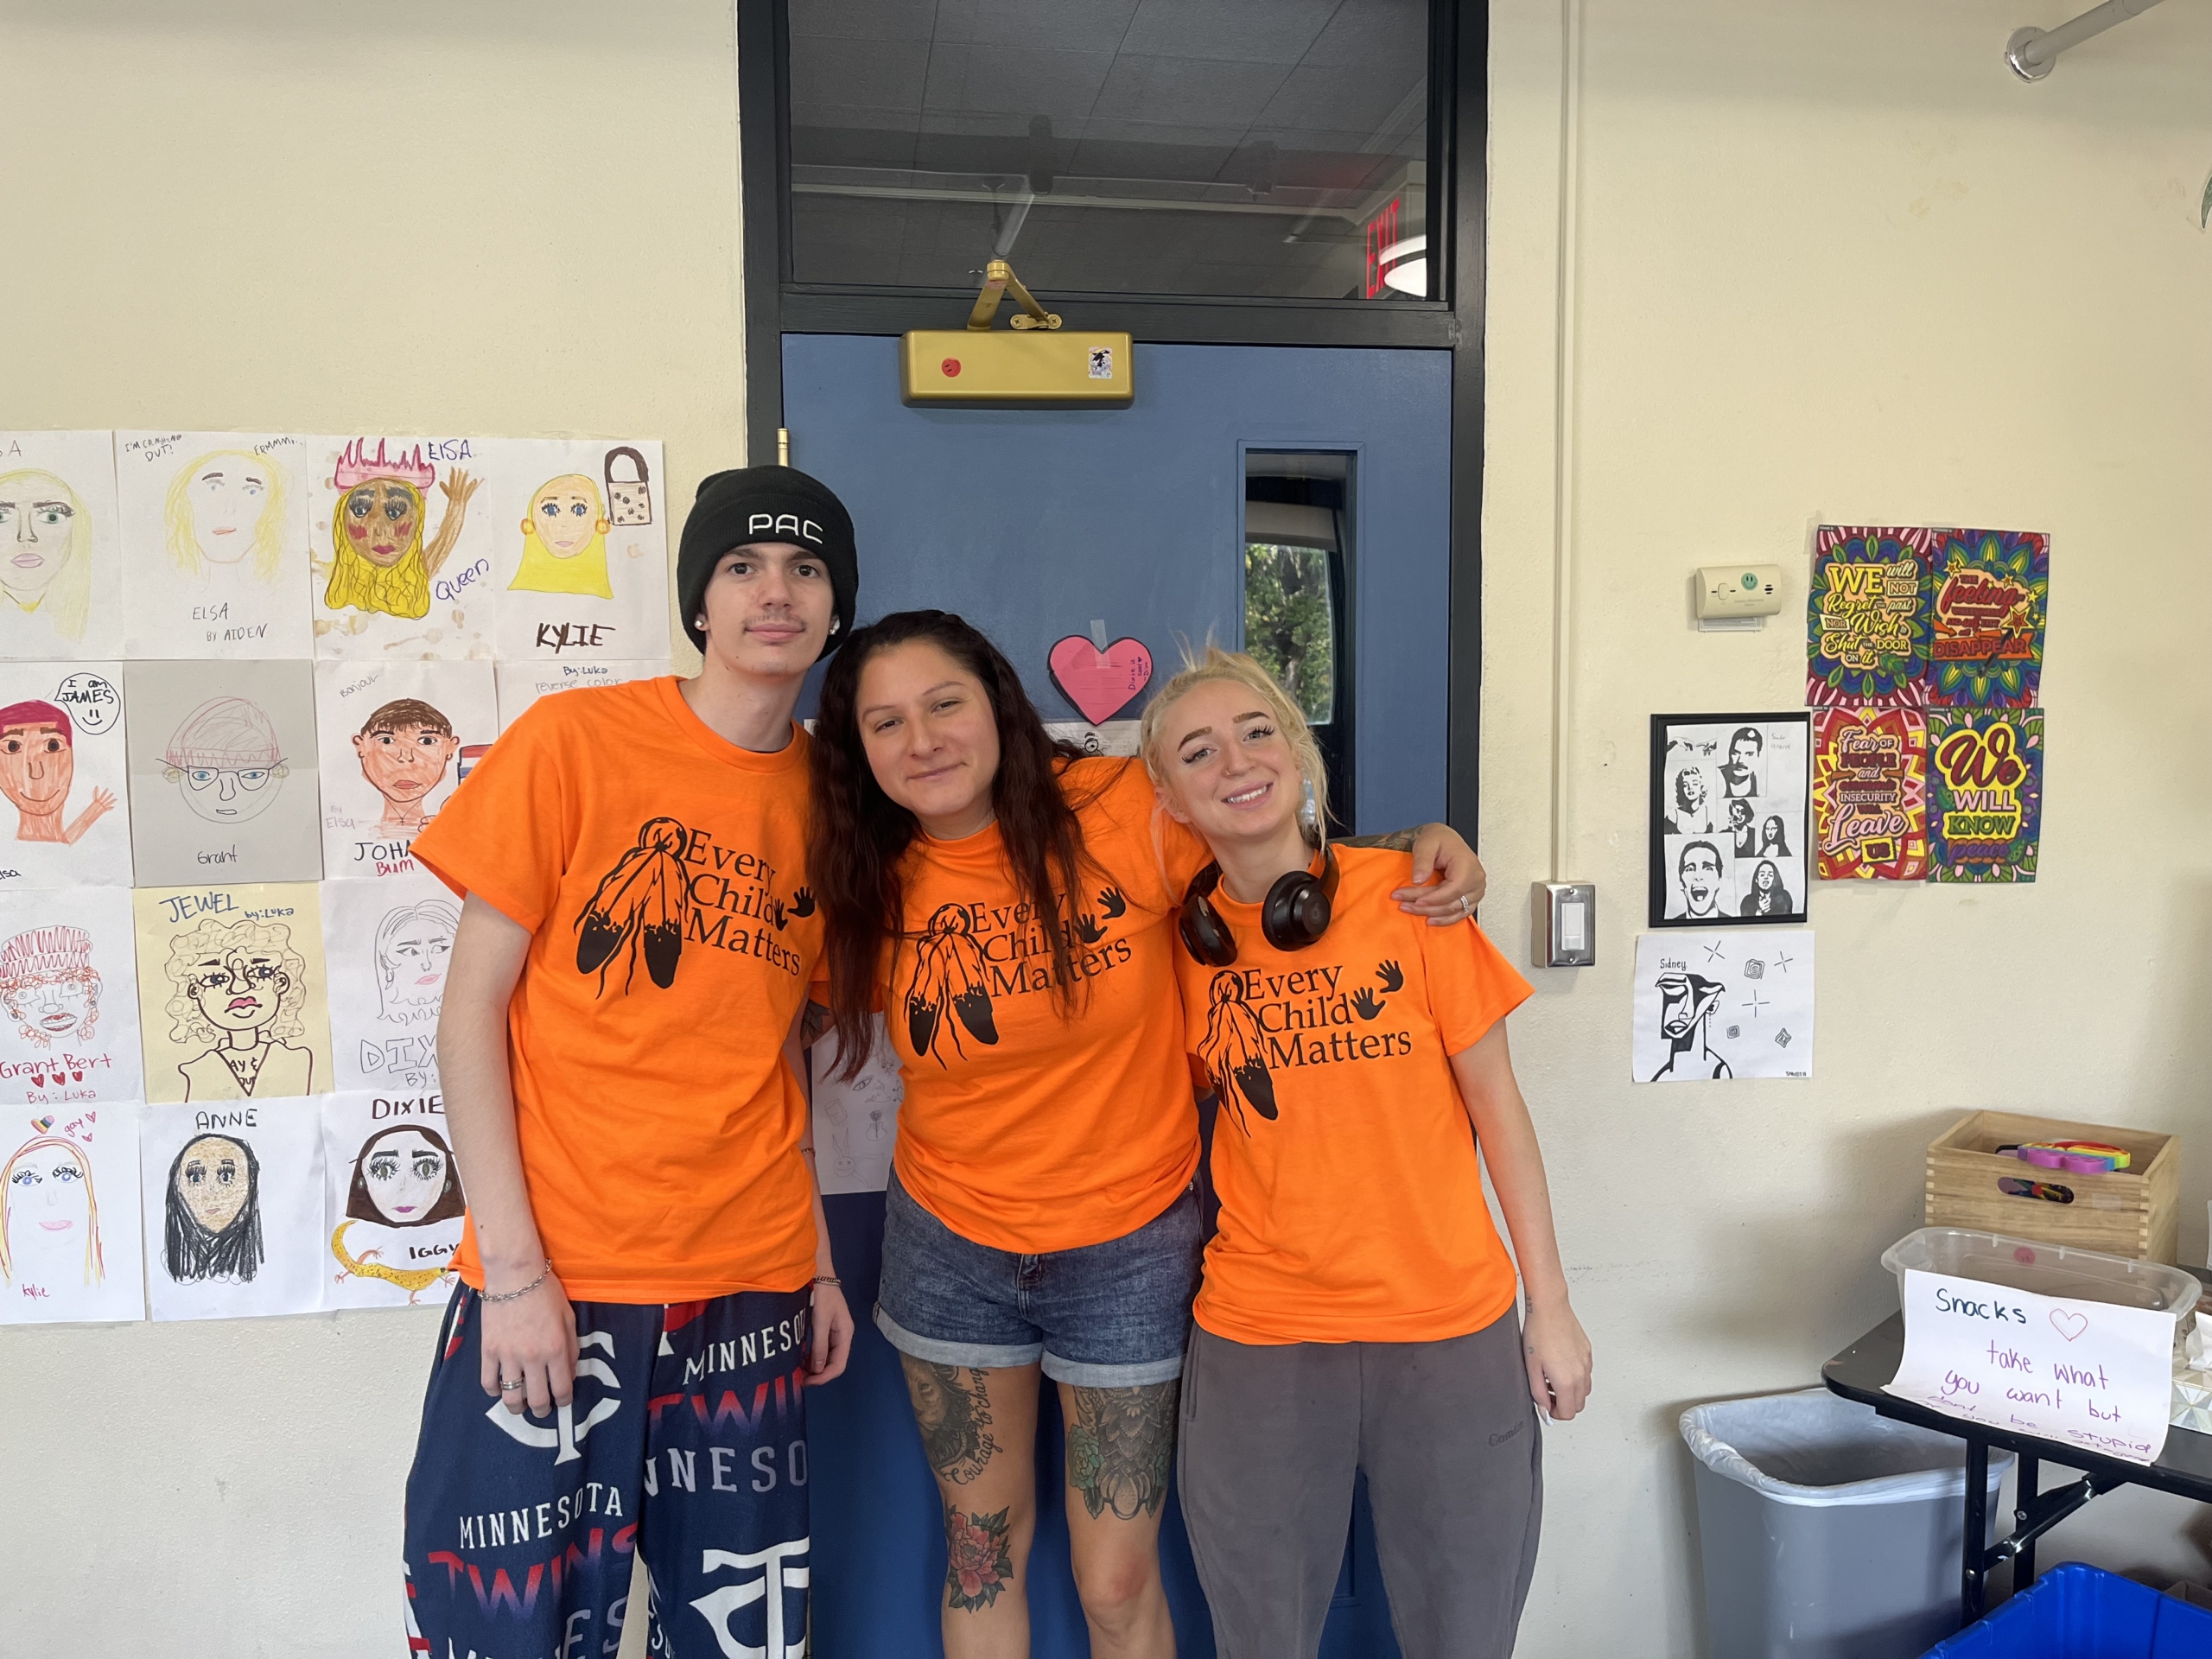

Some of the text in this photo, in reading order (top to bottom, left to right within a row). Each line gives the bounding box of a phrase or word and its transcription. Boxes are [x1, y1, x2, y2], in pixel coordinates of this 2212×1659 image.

[1366, 197, 1400, 300] EXIT
[748, 513, 823, 544] PAC
[1828, 562, 1913, 594] WE will
[1889, 582, 1916, 594] NOT
[1827, 593, 1880, 619] Regret
[1886, 598, 1913, 613] past
[1941, 576, 2018, 619] feeling
[192, 602, 230, 620] ELSA
[1825, 618, 1847, 629] NOR
[1850, 609, 1900, 636] Wish
[224, 623, 268, 641] AIDEN
[536, 622, 616, 654] KYLIE
[1826, 633, 1861, 652] Shut
[1877, 639, 1907, 651] DOOR
[1846, 651, 1874, 664] ON it
[1933, 638, 2026, 658] DISAPPEAR
[88, 679, 108, 689] am
[61, 690, 115, 705] JAMES
[1840, 729, 1892, 753] Fear OF
[1940, 728, 2021, 787] We
[1858, 766, 1879, 779] and
[1840, 792, 1896, 803] INSECURITY
[1953, 790, 2015, 811] WILL
[1824, 804, 1904, 850] Leave
[1948, 816, 2014, 836] KNOW
[683, 828, 777, 897] Every
[1866, 842, 1890, 858] US
[1948, 842, 2009, 867] peace
[158, 891, 239, 924] JEWEL
[690, 874, 776, 926] Child
[683, 907, 801, 976] Matters
[1660, 957, 1688, 971] Sidney
[1242, 965, 1344, 1001] Every
[1258, 993, 1355, 1033] Child
[63, 1052, 112, 1071] Bert
[1268, 1031, 1413, 1070] Matters
[194, 1108, 257, 1130] ANNE
[372, 1095, 445, 1120] DIXIE
[64, 1118, 85, 1137] gay
[1936, 1287, 2027, 1325] Snacks
[1986, 1339, 2033, 1374] take
[1941, 1370, 2121, 1423] you want but
[2010, 1414, 2037, 1429] be
[460, 1481, 623, 1549] MINNESOTA
